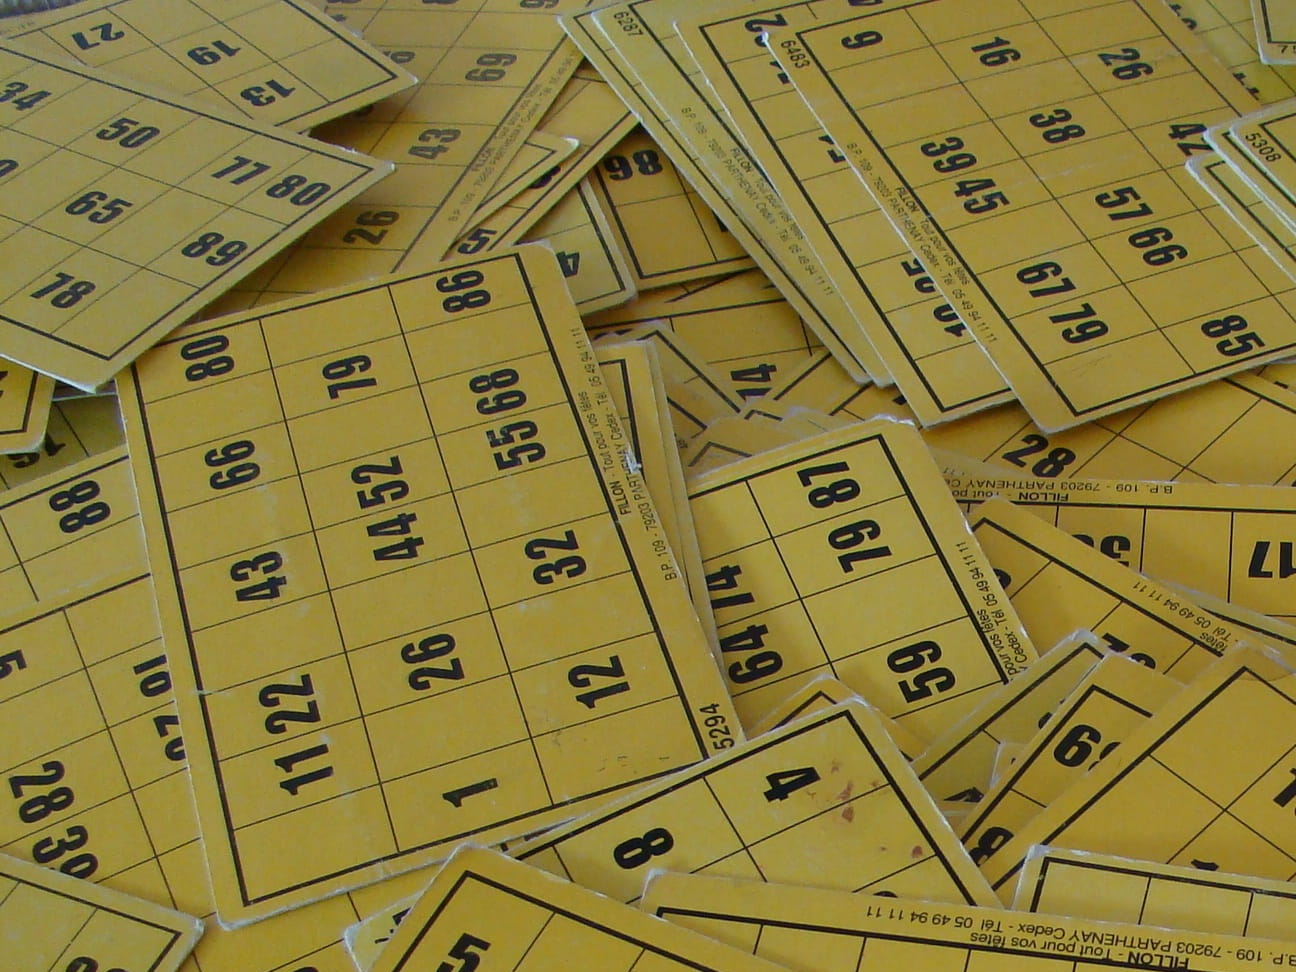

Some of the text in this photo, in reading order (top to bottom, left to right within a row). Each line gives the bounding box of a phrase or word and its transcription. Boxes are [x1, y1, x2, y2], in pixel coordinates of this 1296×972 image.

[71, 22, 125, 50] 27
[971, 36, 1022, 67] 16
[186, 40, 241, 66] 19
[239, 79, 295, 107] 13
[95, 117, 160, 149] 50
[1245, 130, 1282, 163] 5308
[920, 136, 977, 173] 39
[265, 174, 331, 206] 80
[954, 178, 1010, 214] 45
[181, 231, 248, 266] 89
[1048, 302, 1109, 344] 79
[180, 335, 235, 382] 80
[203, 439, 261, 490] 66
[350, 455, 410, 510] 52
[609, 480, 632, 516] FILLON
[796, 461, 861, 509] 87
[1018, 491, 1069, 502] FILLON
[1060, 481, 1138, 493] 79203 109
[48, 480, 111, 534] 88
[365, 512, 425, 562] 44
[523, 529, 587, 585] 32
[1179, 607, 1211, 629] 05 49
[718, 624, 784, 685] 64
[567, 654, 631, 710] 12
[700, 703, 736, 750] 5294
[612, 827, 674, 870] 8
[867, 905, 881, 918] 11
[889, 908, 903, 920] 11
[910, 911, 928, 924] 94
[932, 914, 950, 926] 49
[954, 916, 973, 929] 05
[981, 919, 1003, 932] Tél
[1018, 923, 1065, 939] Cedex
[1071, 929, 1171, 953] PARTHENAY
[970, 932, 1189, 970] FILLON Tout pour vos fêtes
[1176, 942, 1222, 958] 79203
[1237, 949, 1262, 962] 109
